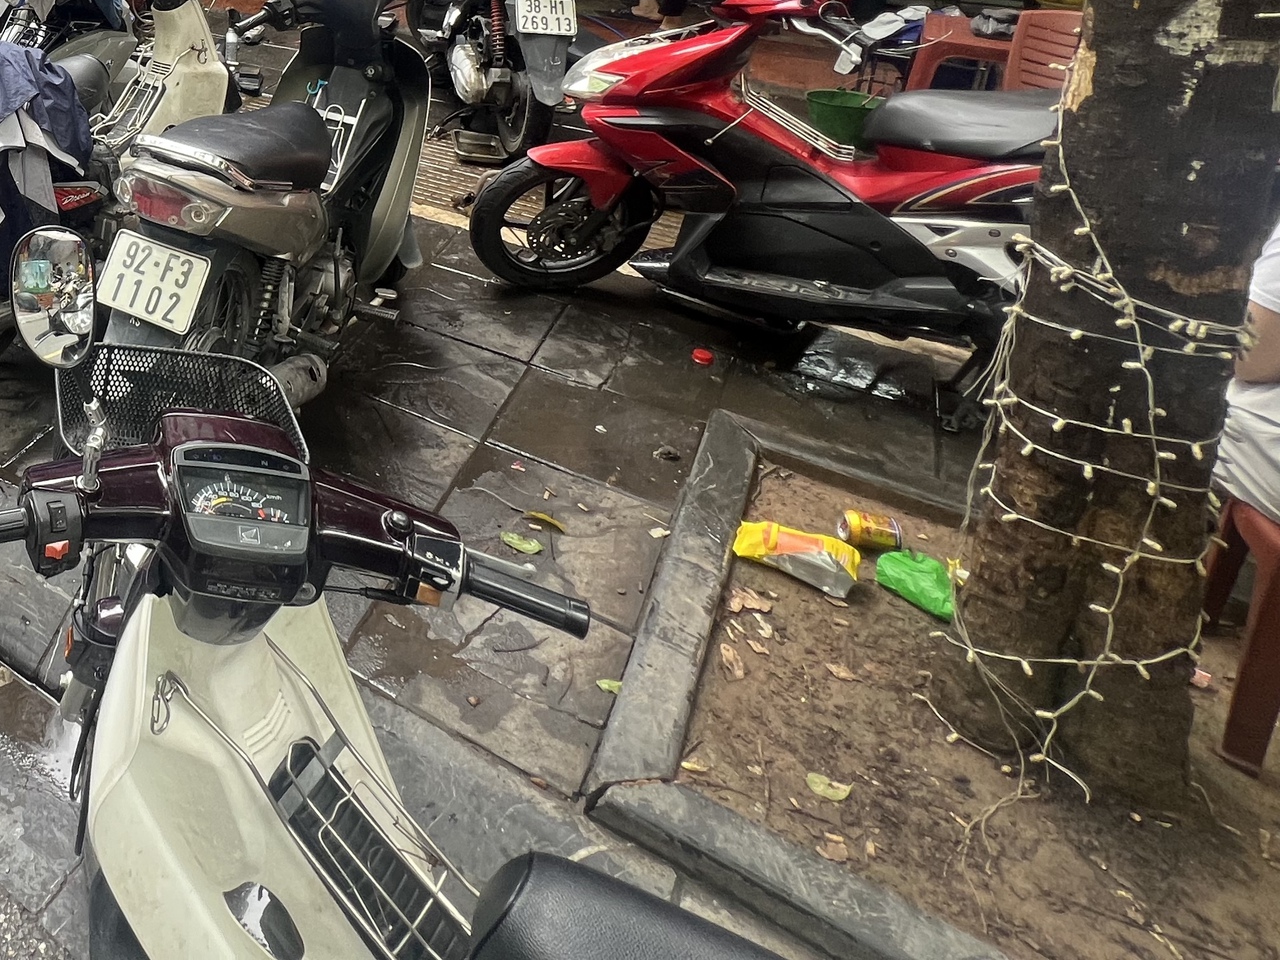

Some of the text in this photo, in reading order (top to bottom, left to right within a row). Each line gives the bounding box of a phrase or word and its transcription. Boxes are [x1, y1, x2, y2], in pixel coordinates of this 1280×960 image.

[521, 15, 572, 32] 269.13
[122, 240, 194, 289] 92-F3
[111, 272, 182, 324] 1102
